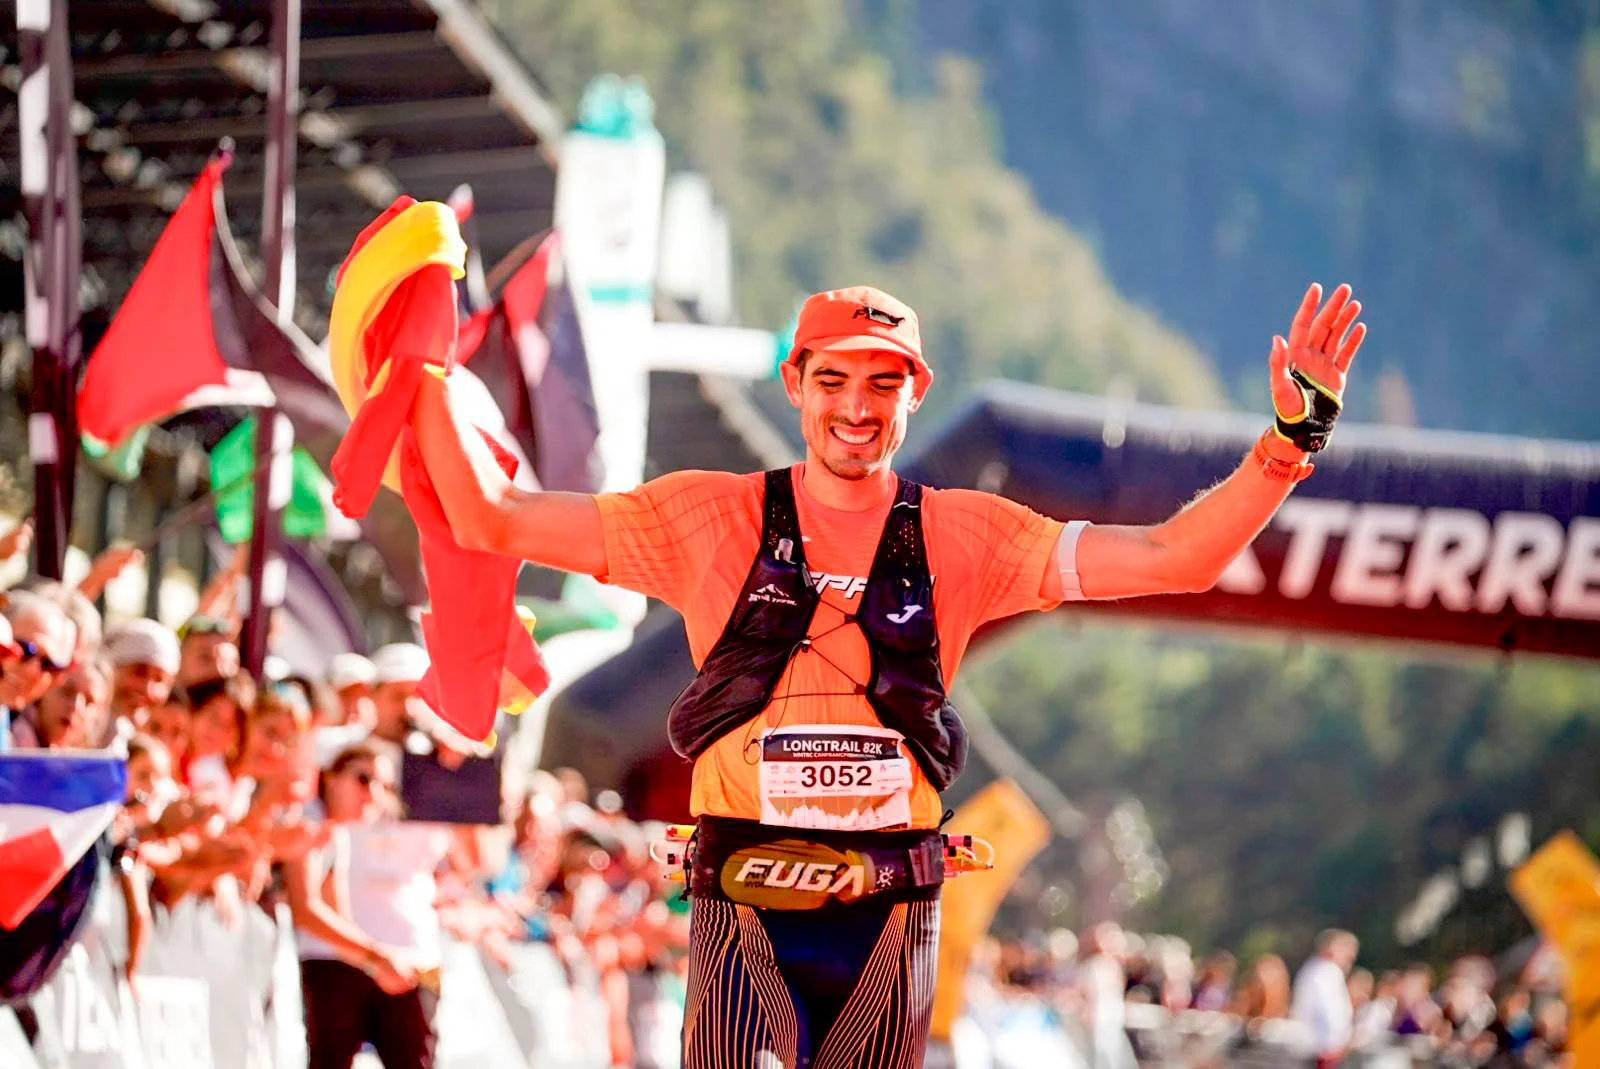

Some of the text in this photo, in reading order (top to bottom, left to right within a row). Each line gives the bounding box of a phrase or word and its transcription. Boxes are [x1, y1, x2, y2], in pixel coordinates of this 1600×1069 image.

[783, 740, 883, 755] LONGTRAIL 82K
[801, 765, 872, 788] 3052
